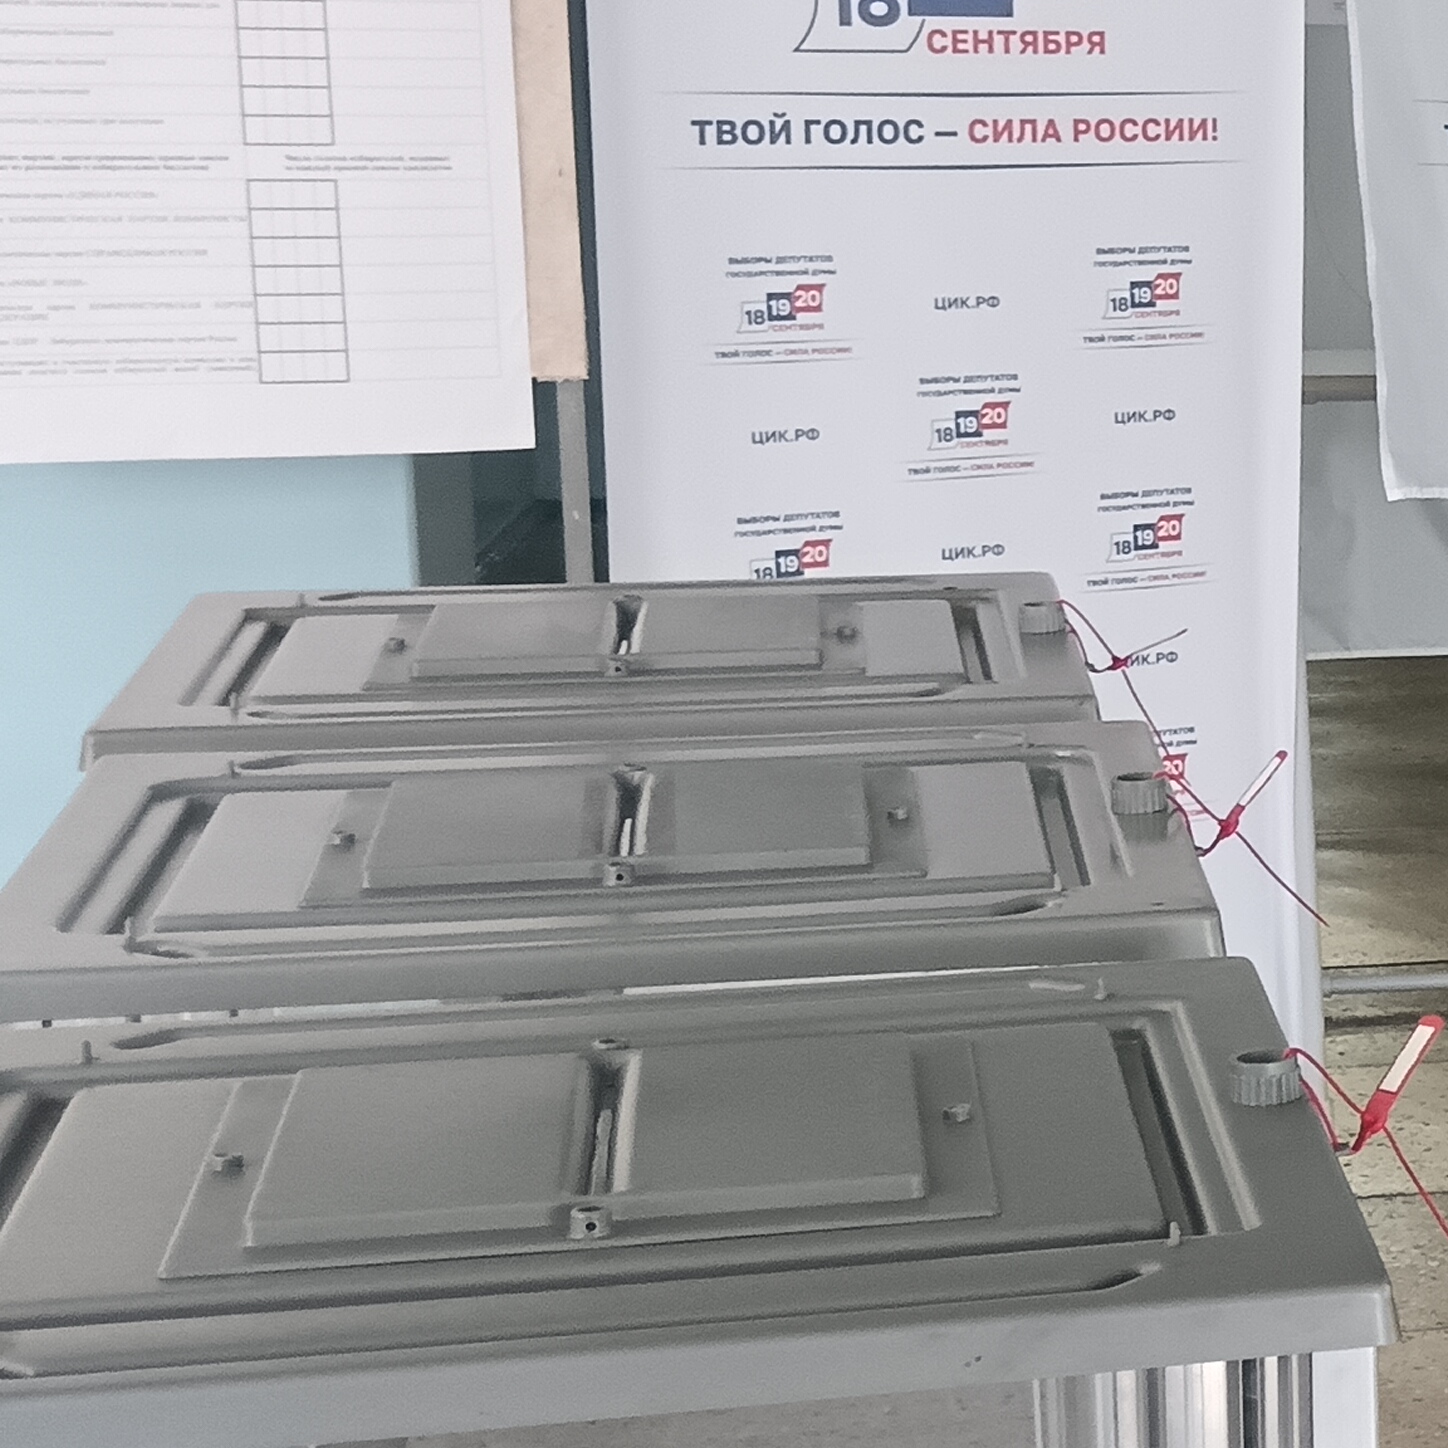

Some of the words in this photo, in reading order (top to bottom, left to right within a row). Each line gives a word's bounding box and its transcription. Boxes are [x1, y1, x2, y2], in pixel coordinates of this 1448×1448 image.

[925, 28, 1107, 56] СЕНТЯБРЯ
[690, 112, 793, 147] ТВОЙ
[802, 118, 926, 147] ГОЛОС
[967, 118, 1063, 145] СИЛА
[1072, 116, 1221, 145] РОССИИ!
[744, 309, 766, 326] 18
[768, 298, 792, 317] 19
[794, 290, 821, 307] 20
[933, 295, 1001, 312] ЦИК.РФ
[1110, 296, 1130, 312] 18
[1131, 286, 1152, 304] 19
[1153, 278, 1179, 295] 20
[935, 427, 955, 443] 18
[956, 415, 979, 434] 19
[980, 407, 1006, 425] 20
[1114, 408, 1177, 425] ЦИК.РФ
[751, 427, 820, 445] ЦИК.РФ
[1113, 540, 1132, 556] 18
[1135, 529, 1155, 547] 19
[1156, 519, 1181, 538] 20
[777, 555, 799, 573] 19
[801, 544, 828, 563] 20
[942, 543, 1006, 562] ЦИК.РФ
[1124, 650, 1179, 666] ИК.РФ
